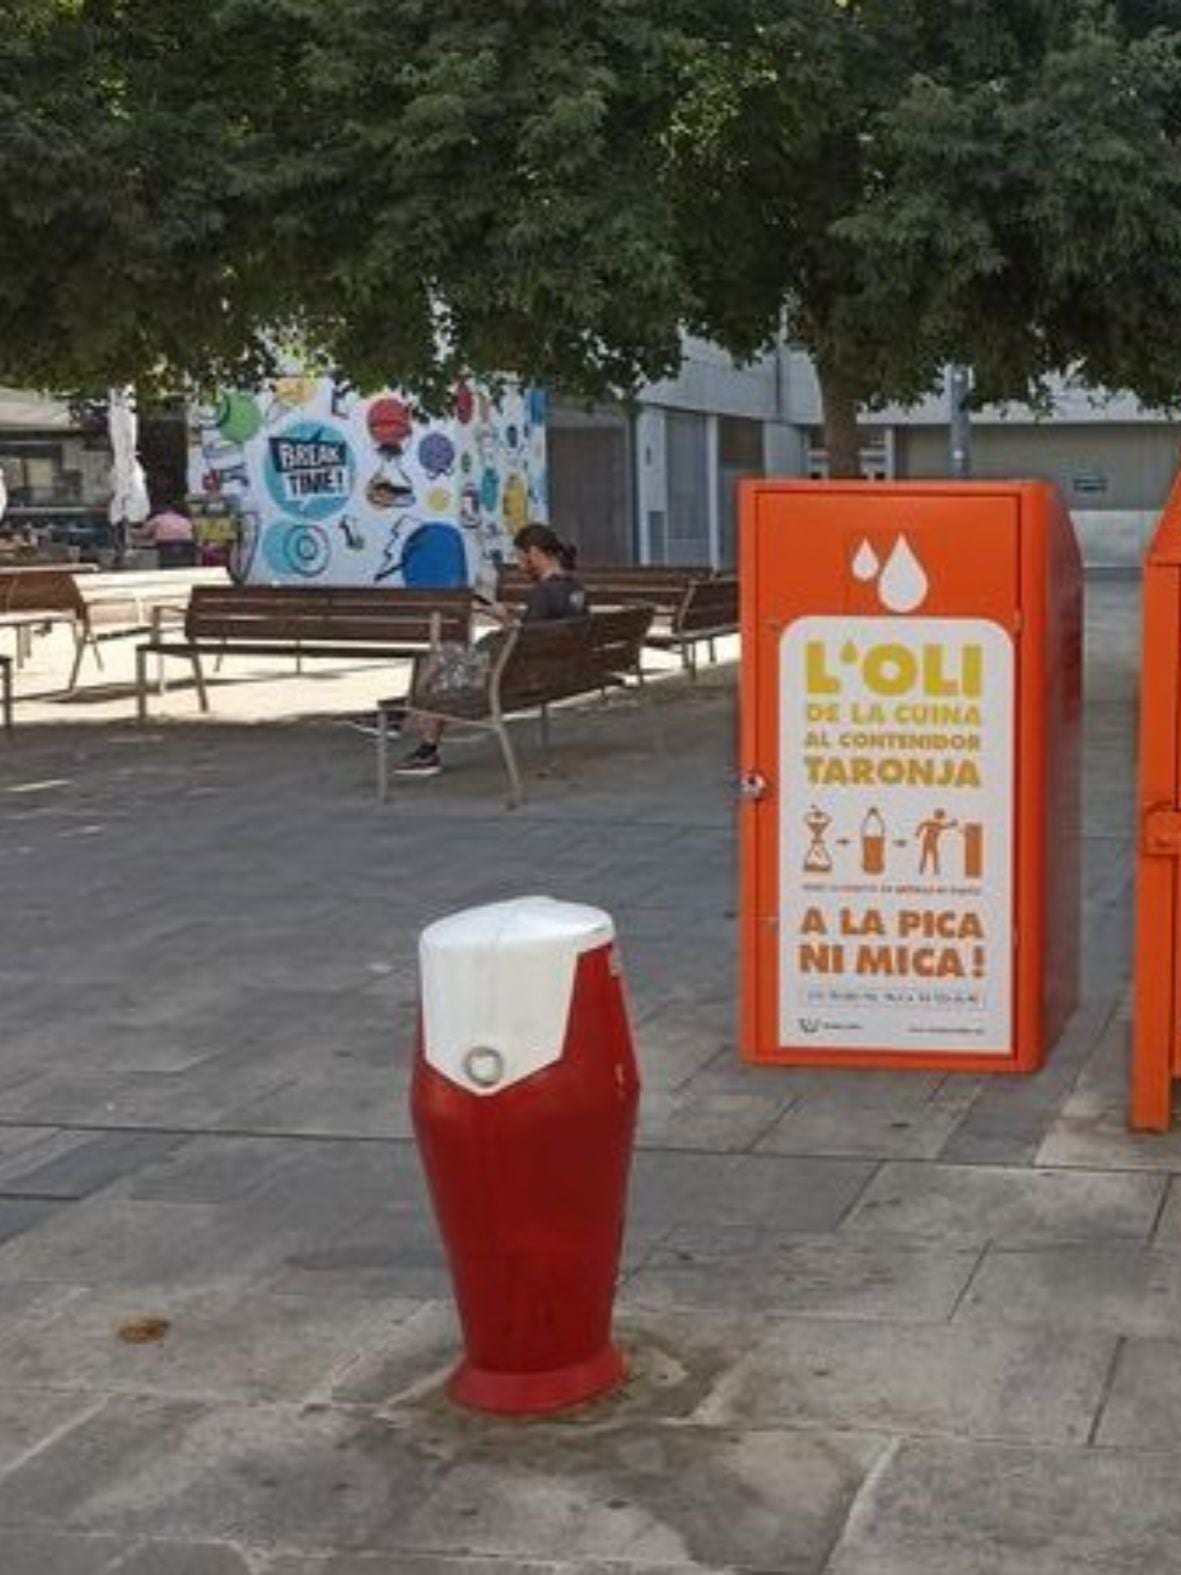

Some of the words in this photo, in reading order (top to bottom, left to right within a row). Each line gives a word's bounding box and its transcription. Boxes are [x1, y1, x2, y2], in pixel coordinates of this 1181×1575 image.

[279, 443, 342, 470] BREAK
[288, 470, 343, 497] TIME!
[806, 638, 982, 697] L'OLI
[806, 704, 838, 723] DE
[851, 704, 886, 725] LA
[895, 705, 981, 726] CUINA
[804, 731, 829, 748] AL
[839, 732, 980, 752] CONTENIDOR
[804, 756, 980, 787] TARONJA
[801, 906, 826, 936] A
[840, 907, 886, 937] LA
[898, 910, 984, 939] PICA
[800, 943, 845, 974] NI
